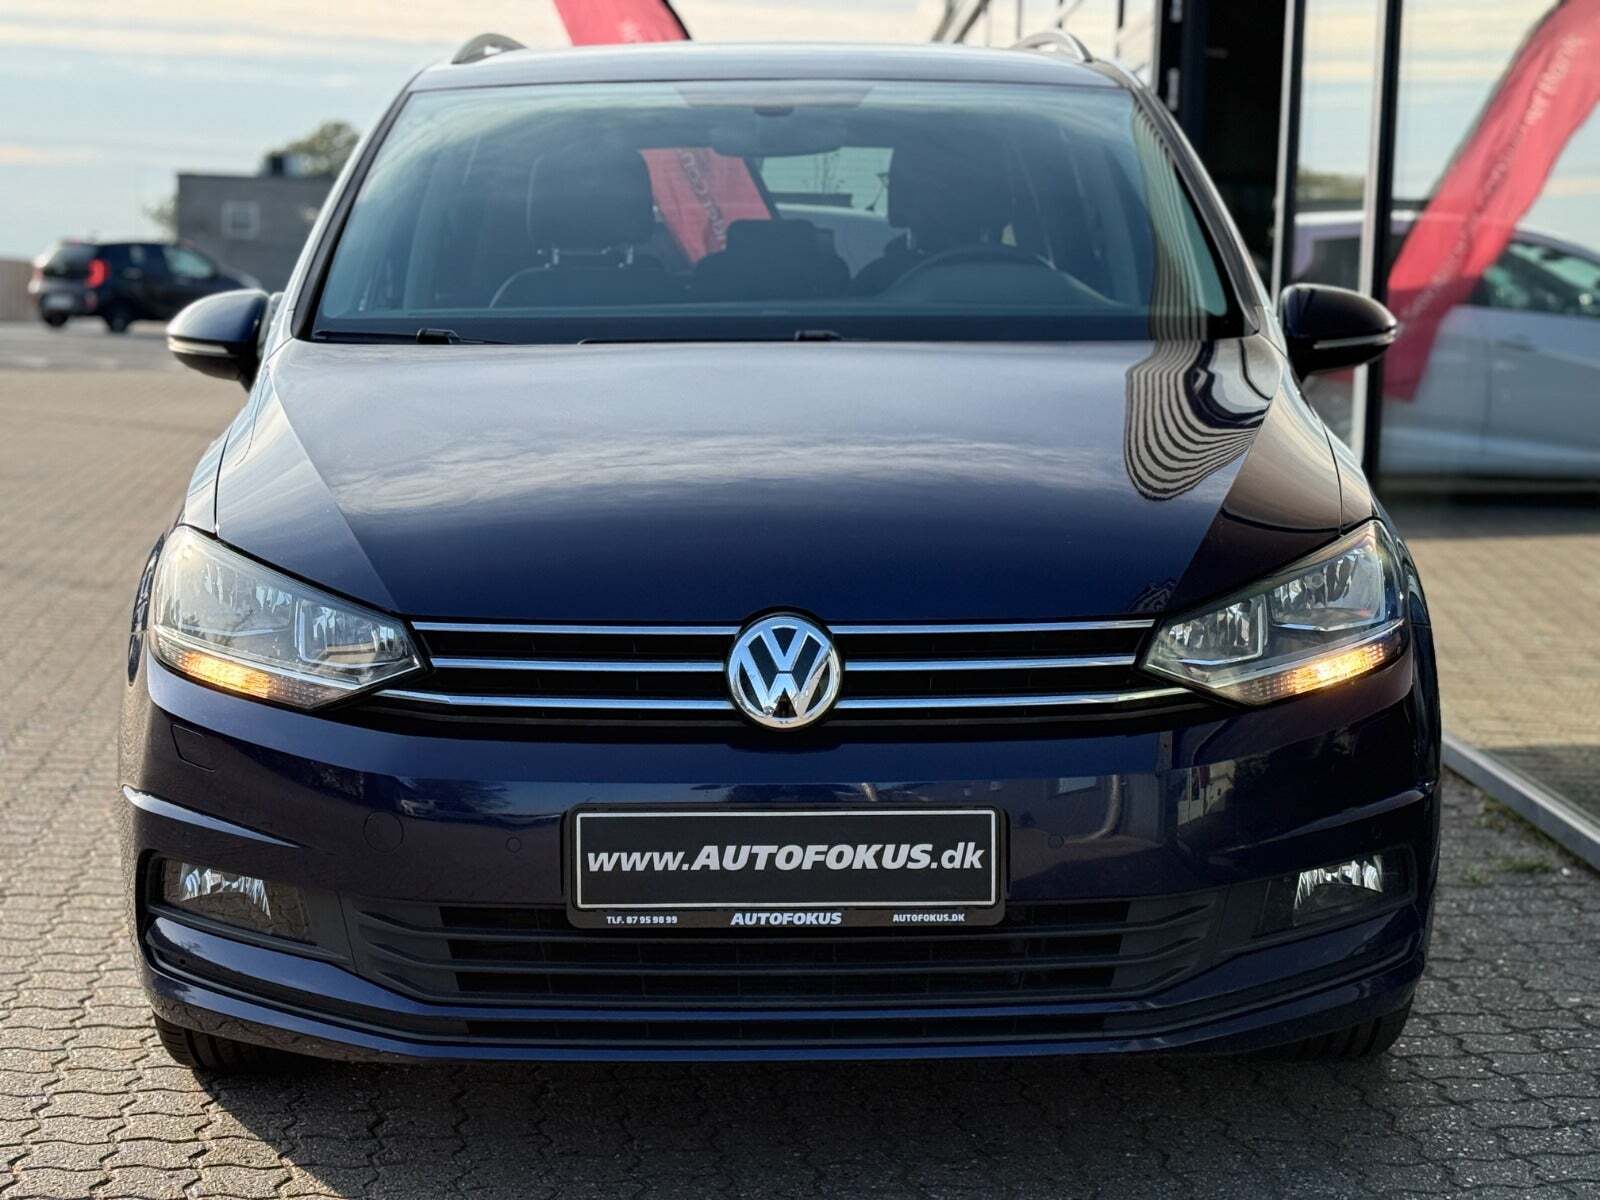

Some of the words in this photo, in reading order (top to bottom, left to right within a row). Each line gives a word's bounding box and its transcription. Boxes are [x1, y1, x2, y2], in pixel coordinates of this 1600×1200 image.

[587, 842, 985, 872] www.AUTOFOKUS.dk
[606, 915, 625, 925] TLF.
[730, 912, 842, 926] AUTOFOKUS
[892, 913, 966, 923] AUTOFOKUS.DK
